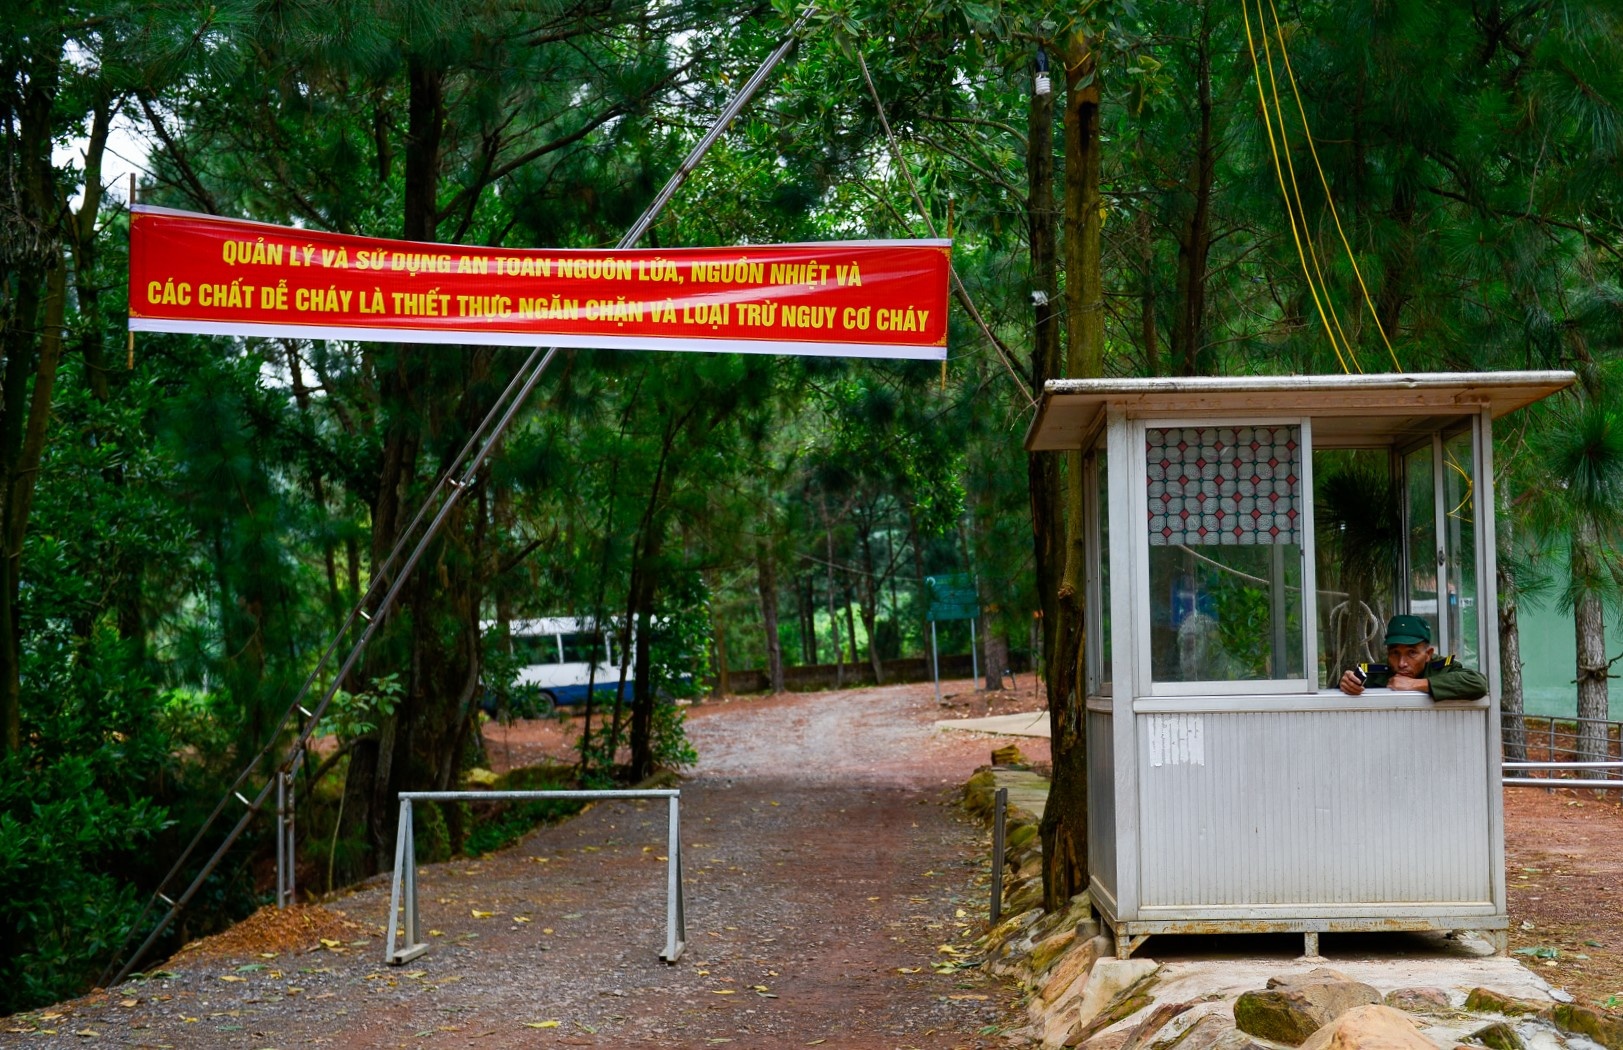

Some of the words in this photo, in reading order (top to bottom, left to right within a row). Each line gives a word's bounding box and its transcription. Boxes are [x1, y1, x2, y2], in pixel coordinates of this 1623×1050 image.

[222, 236, 284, 266] QUẢN
[289, 243, 316, 267] LÝ
[321, 246, 350, 269] VÀ
[355, 248, 388, 271] SỬ
[390, 252, 452, 277] DỤNG
[457, 255, 489, 275] AN
[638, 256, 684, 285] LỬA,
[690, 255, 765, 284] NGUỒN
[769, 259, 831, 288] NHIỆT
[835, 260, 862, 287] VÀ
[147, 277, 192, 306] CÁC
[198, 277, 255, 309] CHẤT
[261, 279, 289, 310] DỄ
[295, 285, 353, 313] CHÁY
[359, 287, 386, 314] LÀ
[391, 287, 451, 317] THIẾT
[456, 294, 513, 322] THỰC
[517, 293, 579, 321] NGĂN
[584, 295, 644, 327] CHẶN
[650, 297, 677, 324] VÀ
[682, 302, 730, 330] LOẠI
[735, 299, 778, 327] TRỪ
[781, 305, 837, 329] NGUY
[842, 306, 871, 330] CƠ
[876, 305, 929, 332] CHÁY
